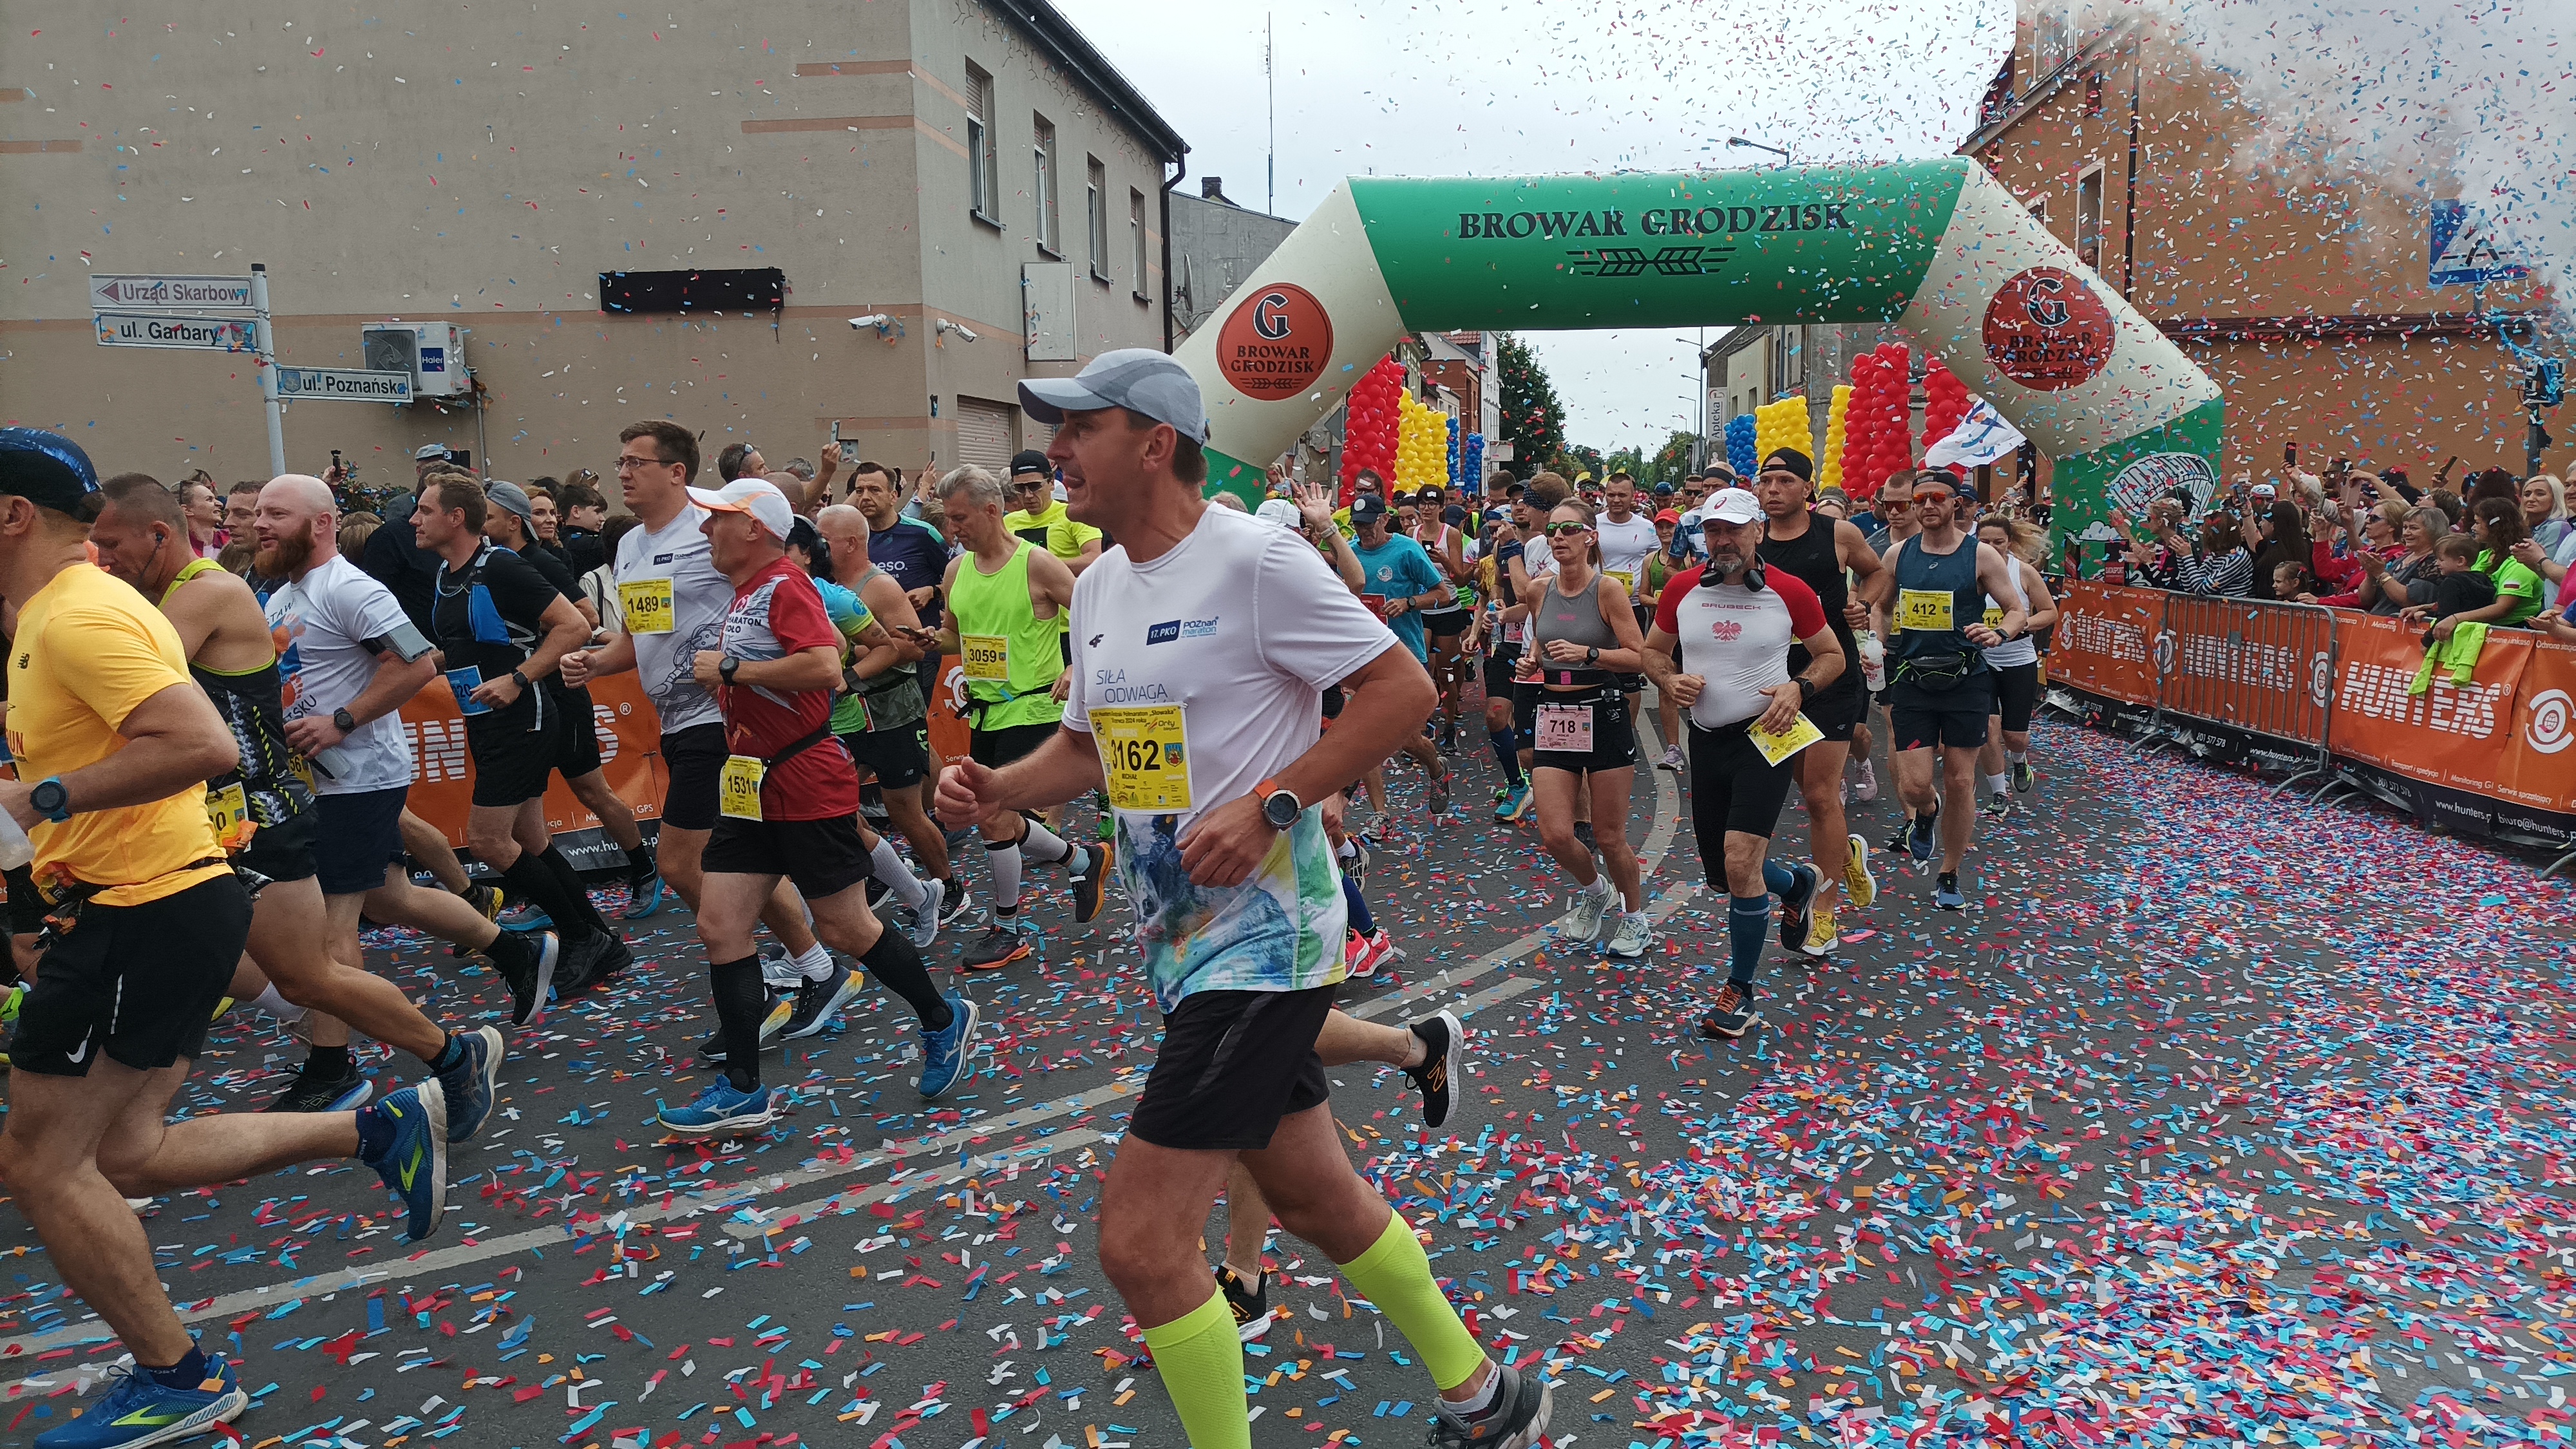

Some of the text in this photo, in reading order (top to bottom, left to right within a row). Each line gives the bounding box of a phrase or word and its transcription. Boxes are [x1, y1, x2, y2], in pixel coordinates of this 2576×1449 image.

[1459, 203, 1851, 239] BROWAR GRODZISK
[123, 283, 248, 305] Urząd Skarbowy
[1253, 293, 1292, 340] G
[120, 321, 218, 346] ul. Garbary
[1237, 345, 1309, 359] BROWAR
[1231, 360, 1314, 373] GRODZISK
[303, 375, 321, 392] ul.
[1711, 402, 1722, 439] Apteka
[628, 596, 659, 613] 1489
[1912, 603, 1937, 615] 412
[1182, 626, 1217, 635] maraton
[969, 649, 997, 663] 3059
[2185, 633, 2295, 692] HUNTERS
[1096, 668, 1126, 685] SIŁA
[1104, 683, 1168, 703] ODWAGA
[2341, 660, 2501, 739] HUNTERS
[1549, 720, 1576, 733] 718
[1111, 739, 1160, 771] 3162
[2250, 748, 2303, 764] www.hunters.pl
[2391, 759, 2414, 772] Transport
[728, 775, 752, 795] 1531
[2450, 774, 2483, 789] Monitoring
[636, 804, 654, 814] GPS
